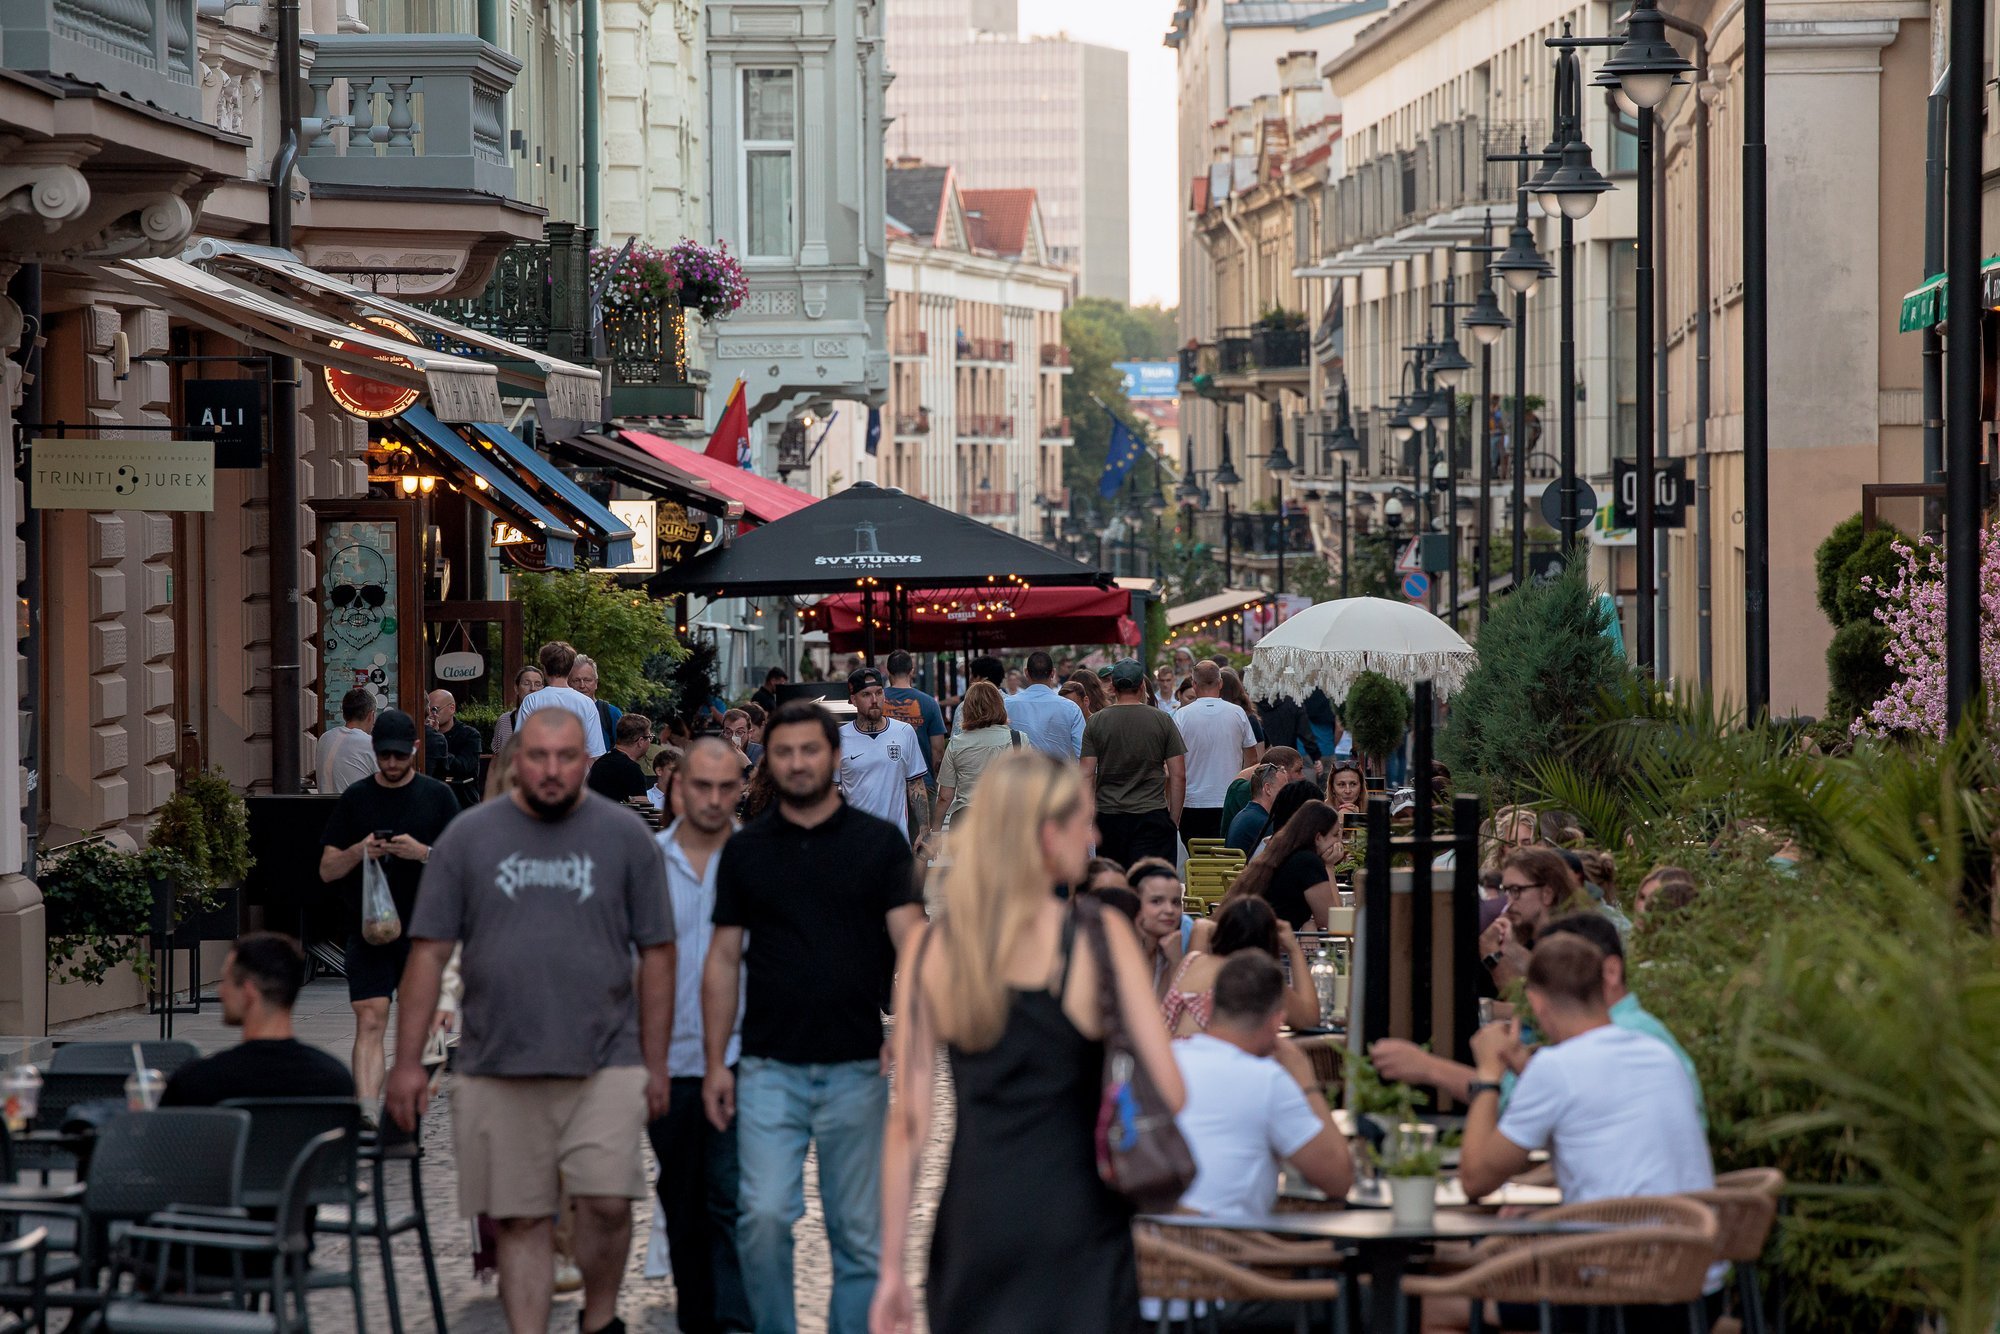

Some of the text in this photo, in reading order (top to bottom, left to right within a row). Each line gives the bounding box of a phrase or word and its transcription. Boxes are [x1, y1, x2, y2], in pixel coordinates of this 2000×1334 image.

[201, 407, 243, 426] ALI
[37, 470, 207, 487] TRINITI JUREX
[1622, 471, 1677, 515] grü
[815, 555, 922, 565] ŠVYTURYS
[947, 611, 976, 620] ESTRELLA
[443, 666, 477, 678] Closed
